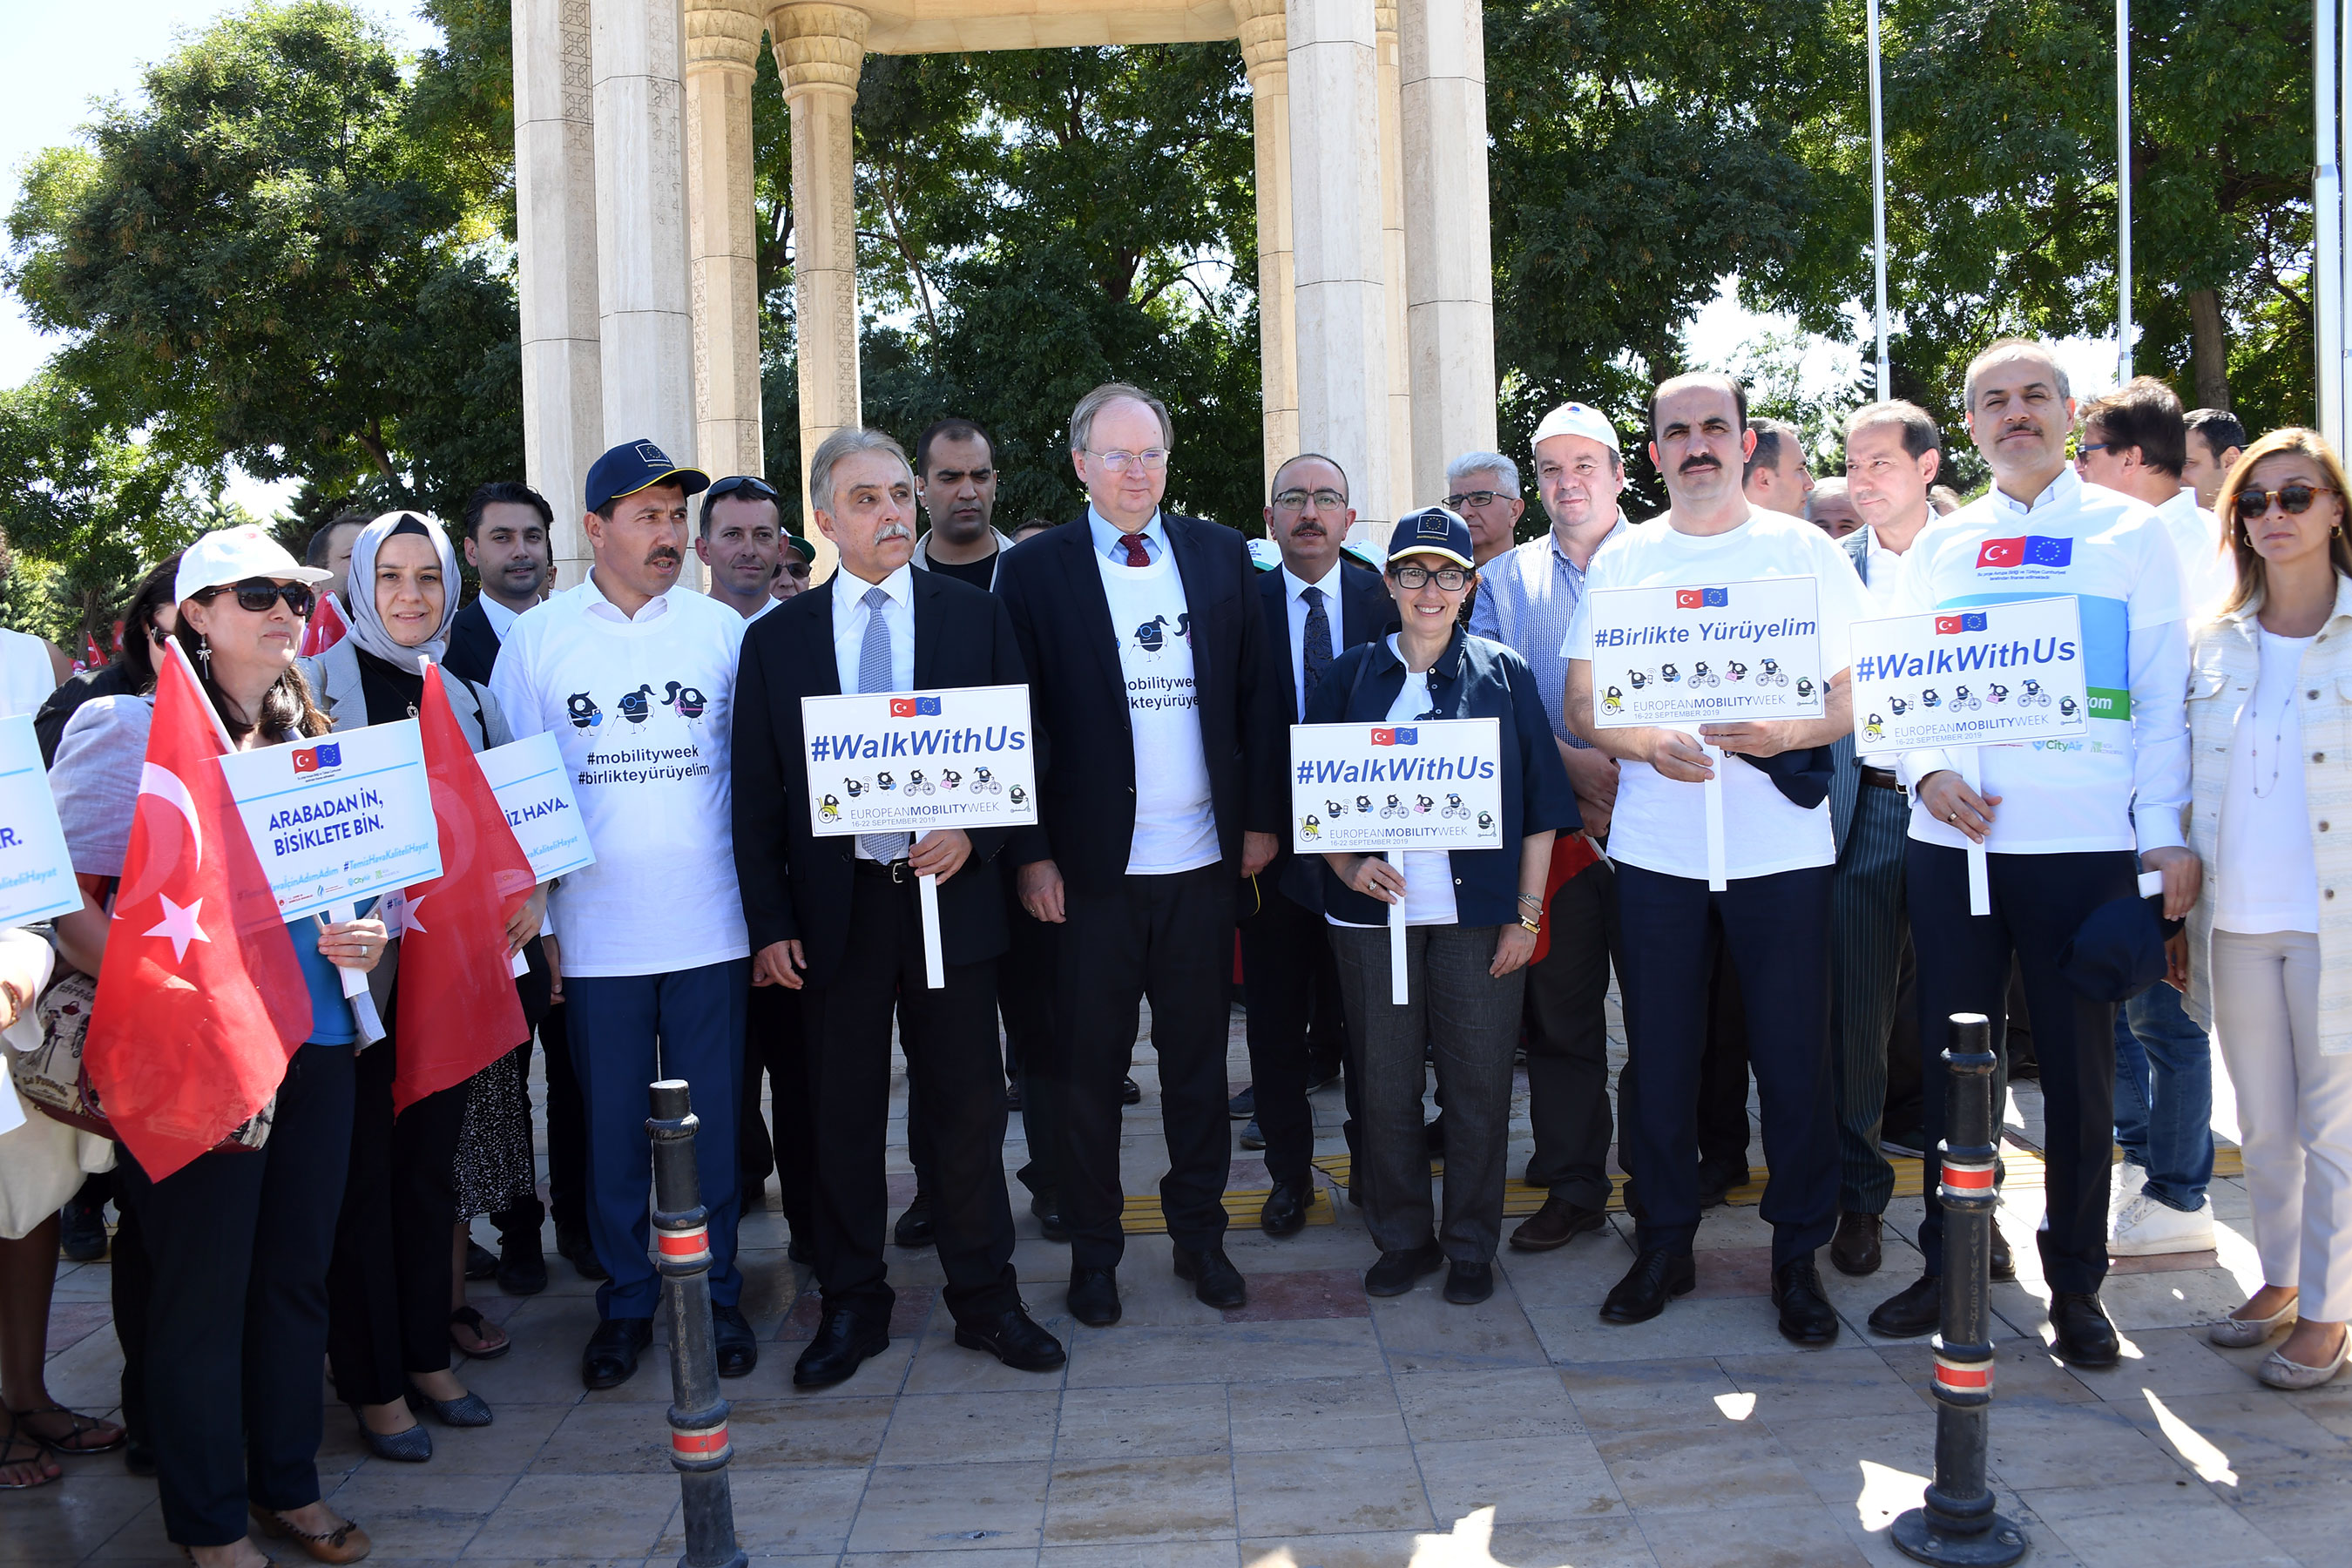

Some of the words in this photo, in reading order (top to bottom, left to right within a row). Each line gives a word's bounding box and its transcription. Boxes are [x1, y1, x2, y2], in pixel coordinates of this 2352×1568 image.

[1594, 625, 1690, 648] #Birlikte
[1699, 618, 1816, 643] Yürüyelim
[1856, 637, 2076, 682] #WalkWithUs
[1128, 676, 1196, 692] obilitywe
[1126, 693, 1199, 711] kteyürüye
[1633, 694, 1786, 712] EUROPEANMOBILITYWEEK
[1654, 710, 1700, 719] SEPTEMBER
[1895, 713, 2049, 738] EUROPEANMOBILITYWEEK
[811, 726, 1025, 762] #WalkWithUs
[1916, 734, 1963, 744] SEPTEMBER
[587, 744, 699, 766] #mobilityweek
[578, 763, 710, 785] #birlikteyürüyelim
[1297, 756, 1495, 785] #WalkWithUs
[269, 794, 359, 831] ARABADAN
[360, 787, 384, 808] İN,
[504, 809, 522, 828] İZ
[522, 797, 569, 821] HAVA.
[850, 801, 1000, 820] EUROPEANMOBILITYWEEK
[872, 818, 917, 827] SEPTEMBER
[1329, 827, 1468, 839] EUROPEANMOBILITYWEEK
[0, 827, 23, 849] R.
[274, 821, 352, 856] BİSİKLETE
[353, 812, 384, 836] BİN.
[526, 835, 578, 858] vaKaliteliHayat
